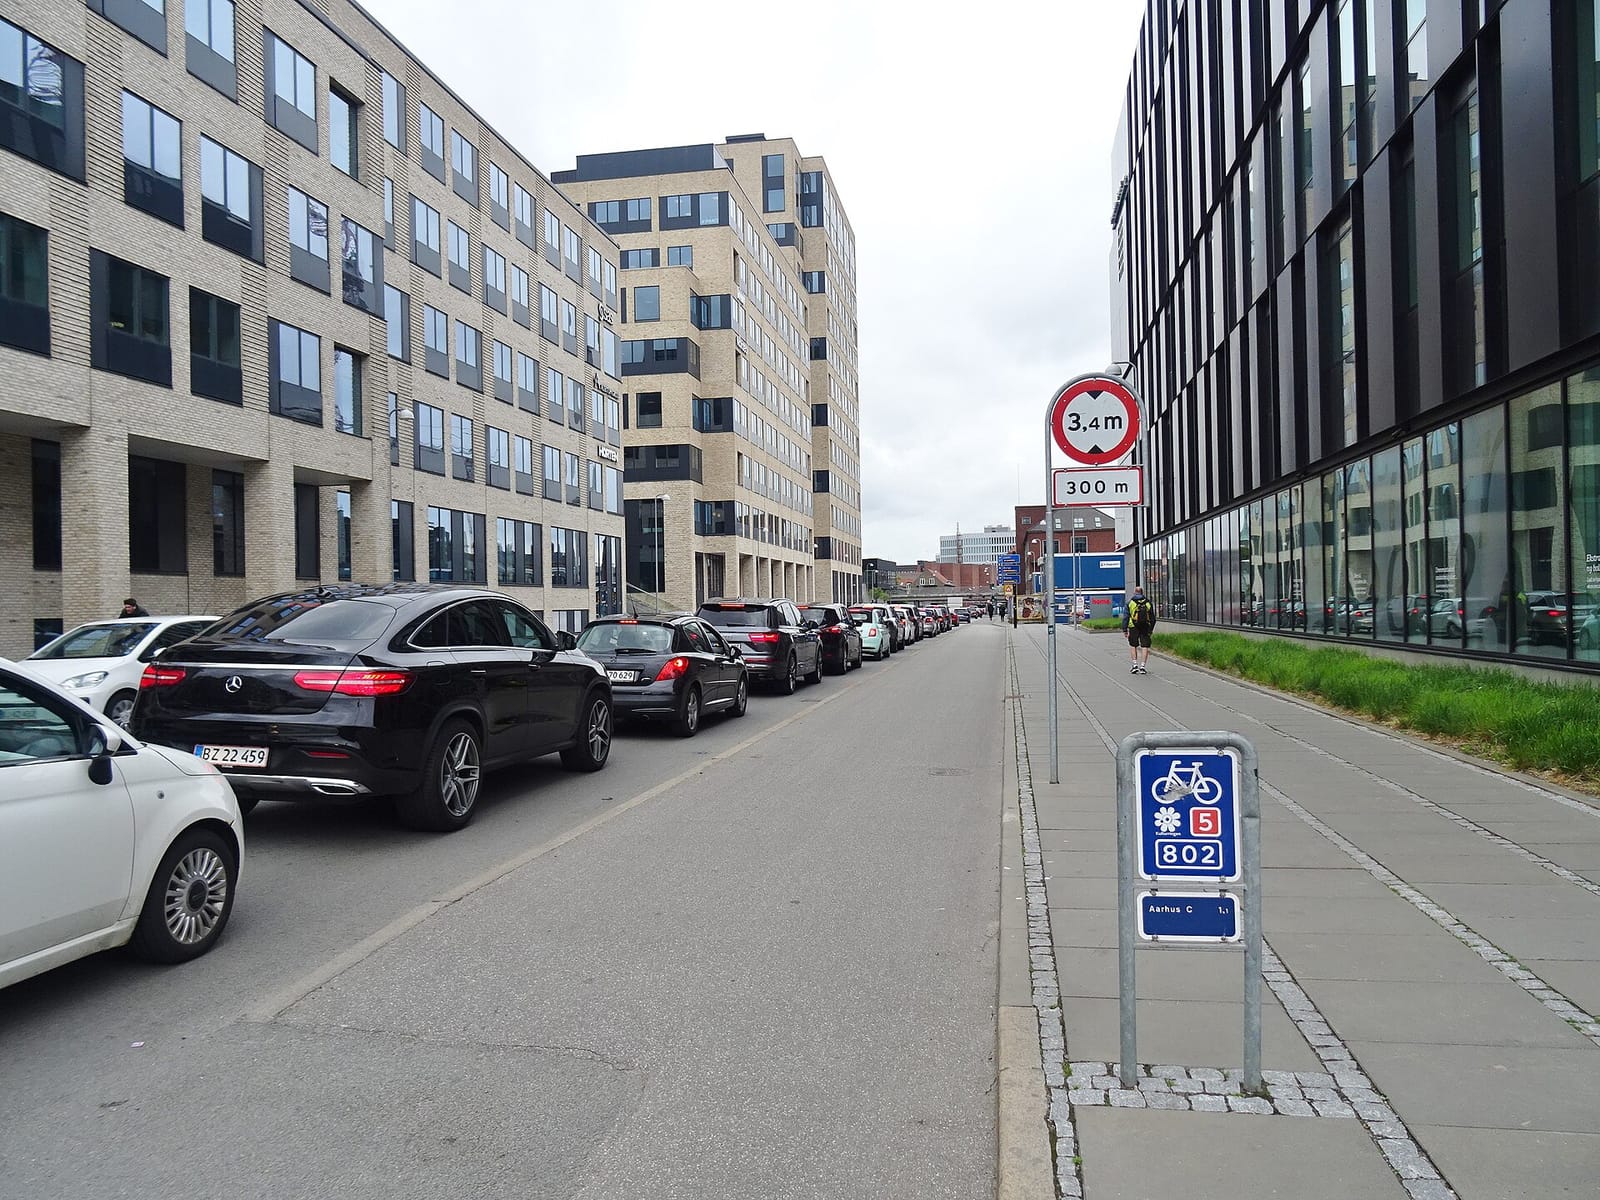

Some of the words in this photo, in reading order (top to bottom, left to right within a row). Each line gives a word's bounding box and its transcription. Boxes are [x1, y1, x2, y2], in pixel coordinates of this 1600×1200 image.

[1067, 412, 1100, 432] 3,4
[1104, 415, 1122, 430] m
[1066, 480, 1106, 495] 300
[1114, 482, 1128, 493] m
[618, 671, 633, 680] 629
[202, 747, 220, 761] BZ
[222, 748, 238, 762] 22
[240, 749, 265, 763] 459
[1198, 812, 1213, 832] 5
[1162, 844, 1215, 864] 802
[1149, 905, 1181, 913] Aarhus
[1186, 905, 1193, 913] C
